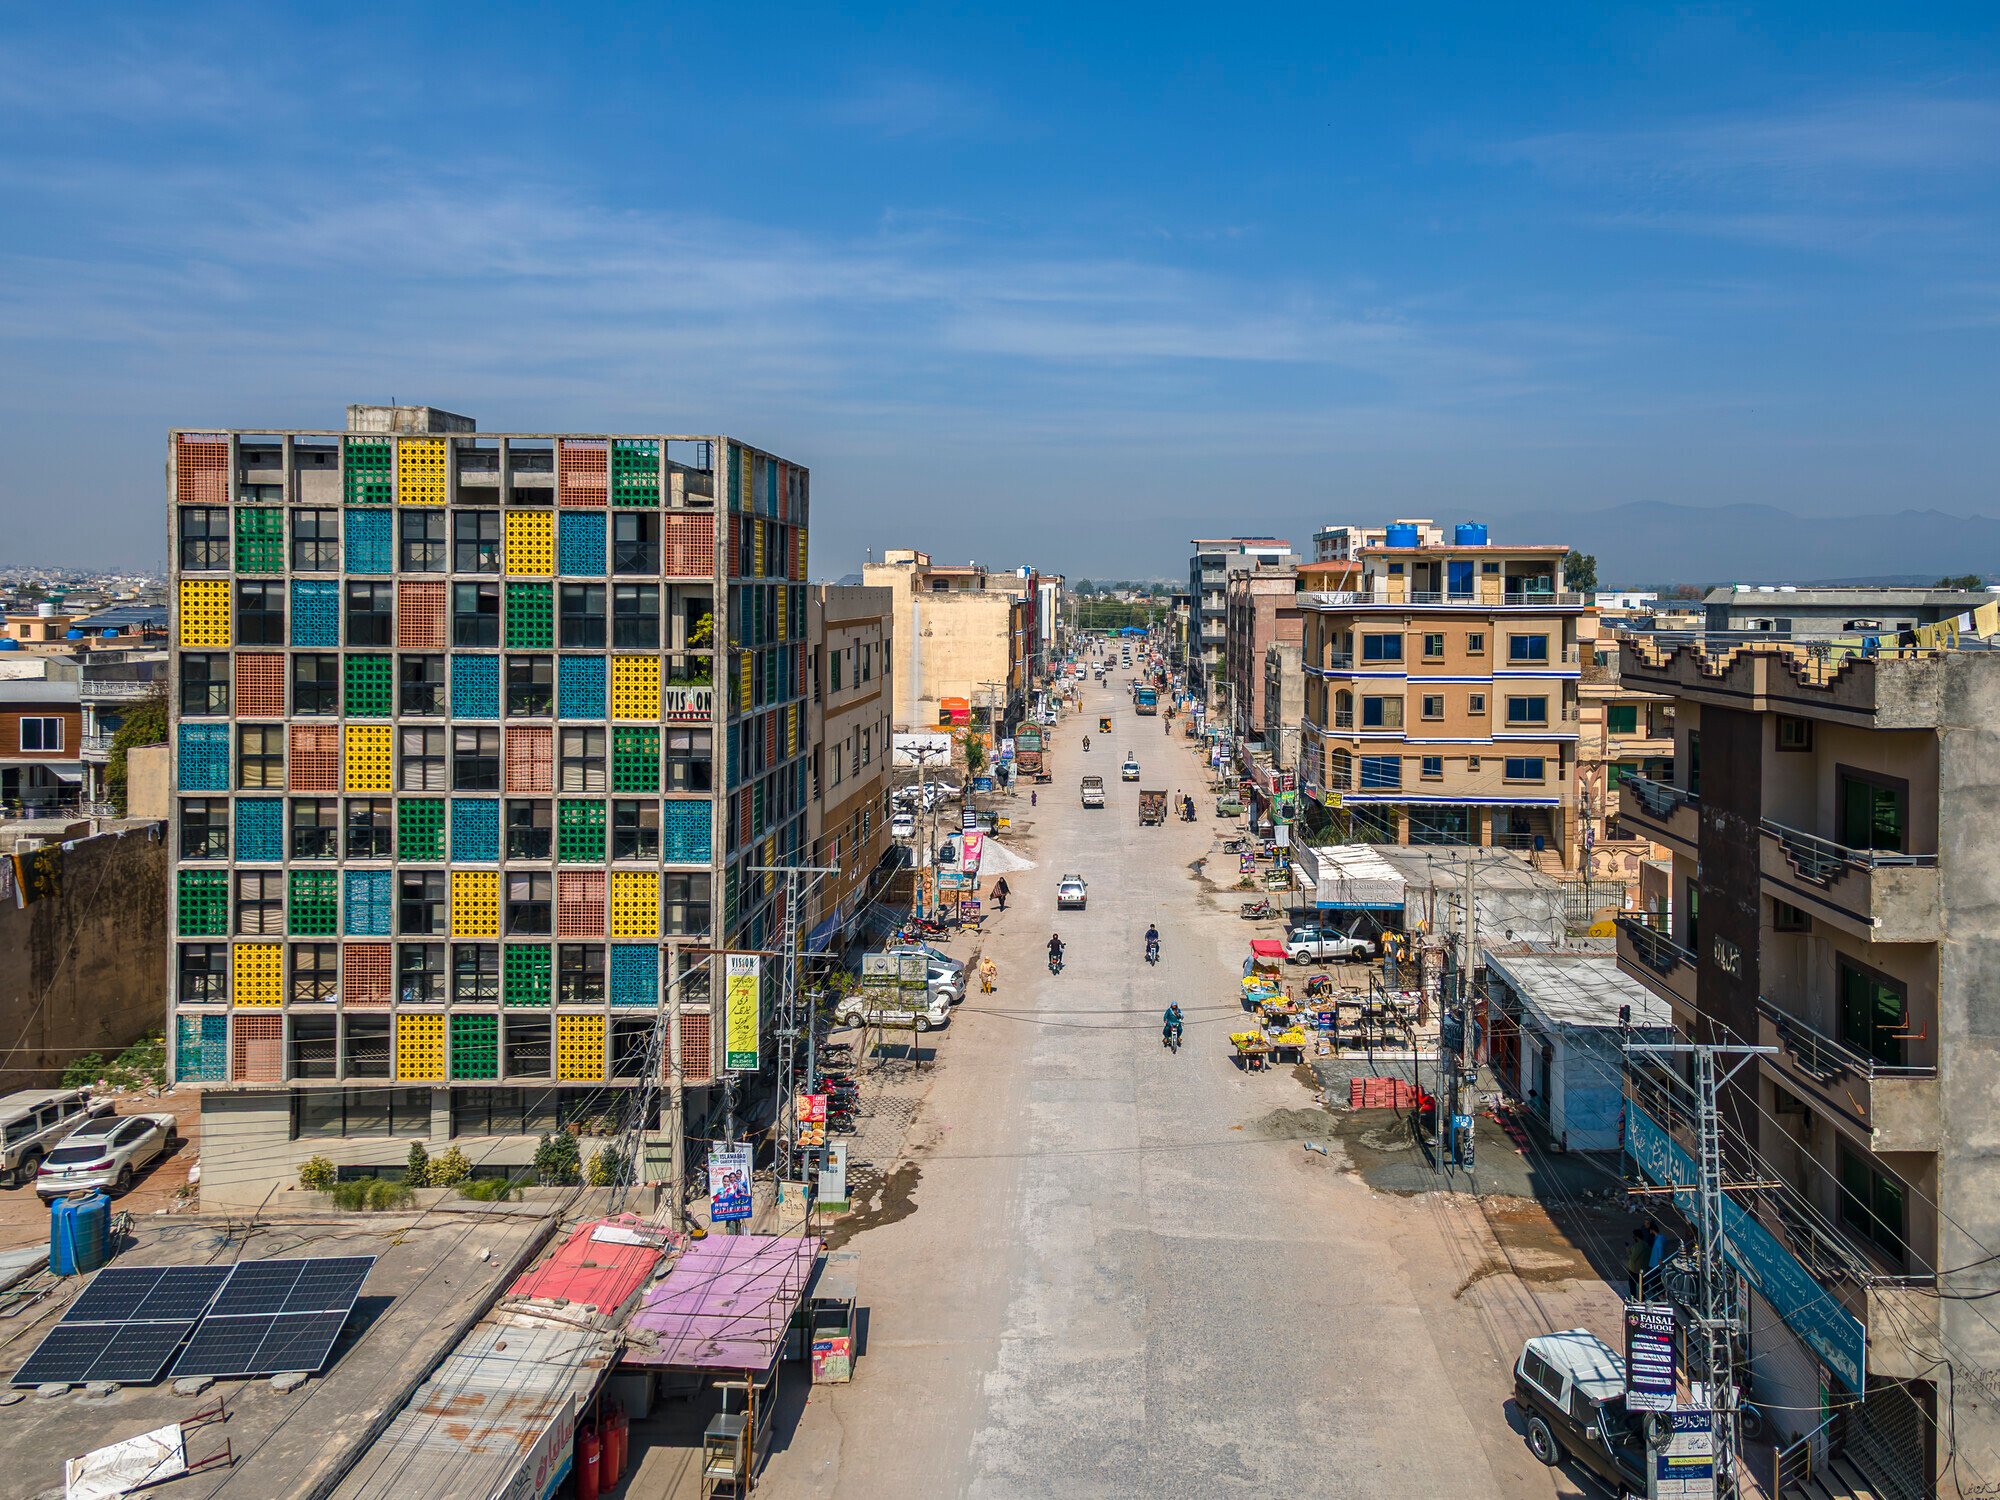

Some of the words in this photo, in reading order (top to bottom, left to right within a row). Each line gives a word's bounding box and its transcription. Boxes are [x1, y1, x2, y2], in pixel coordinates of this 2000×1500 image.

[667, 690, 711, 711] VISION
[731, 957, 753, 968] VISION
[1640, 1314, 1675, 1326] FAISAL
[1640, 1323, 1674, 1332] SCHOOL
